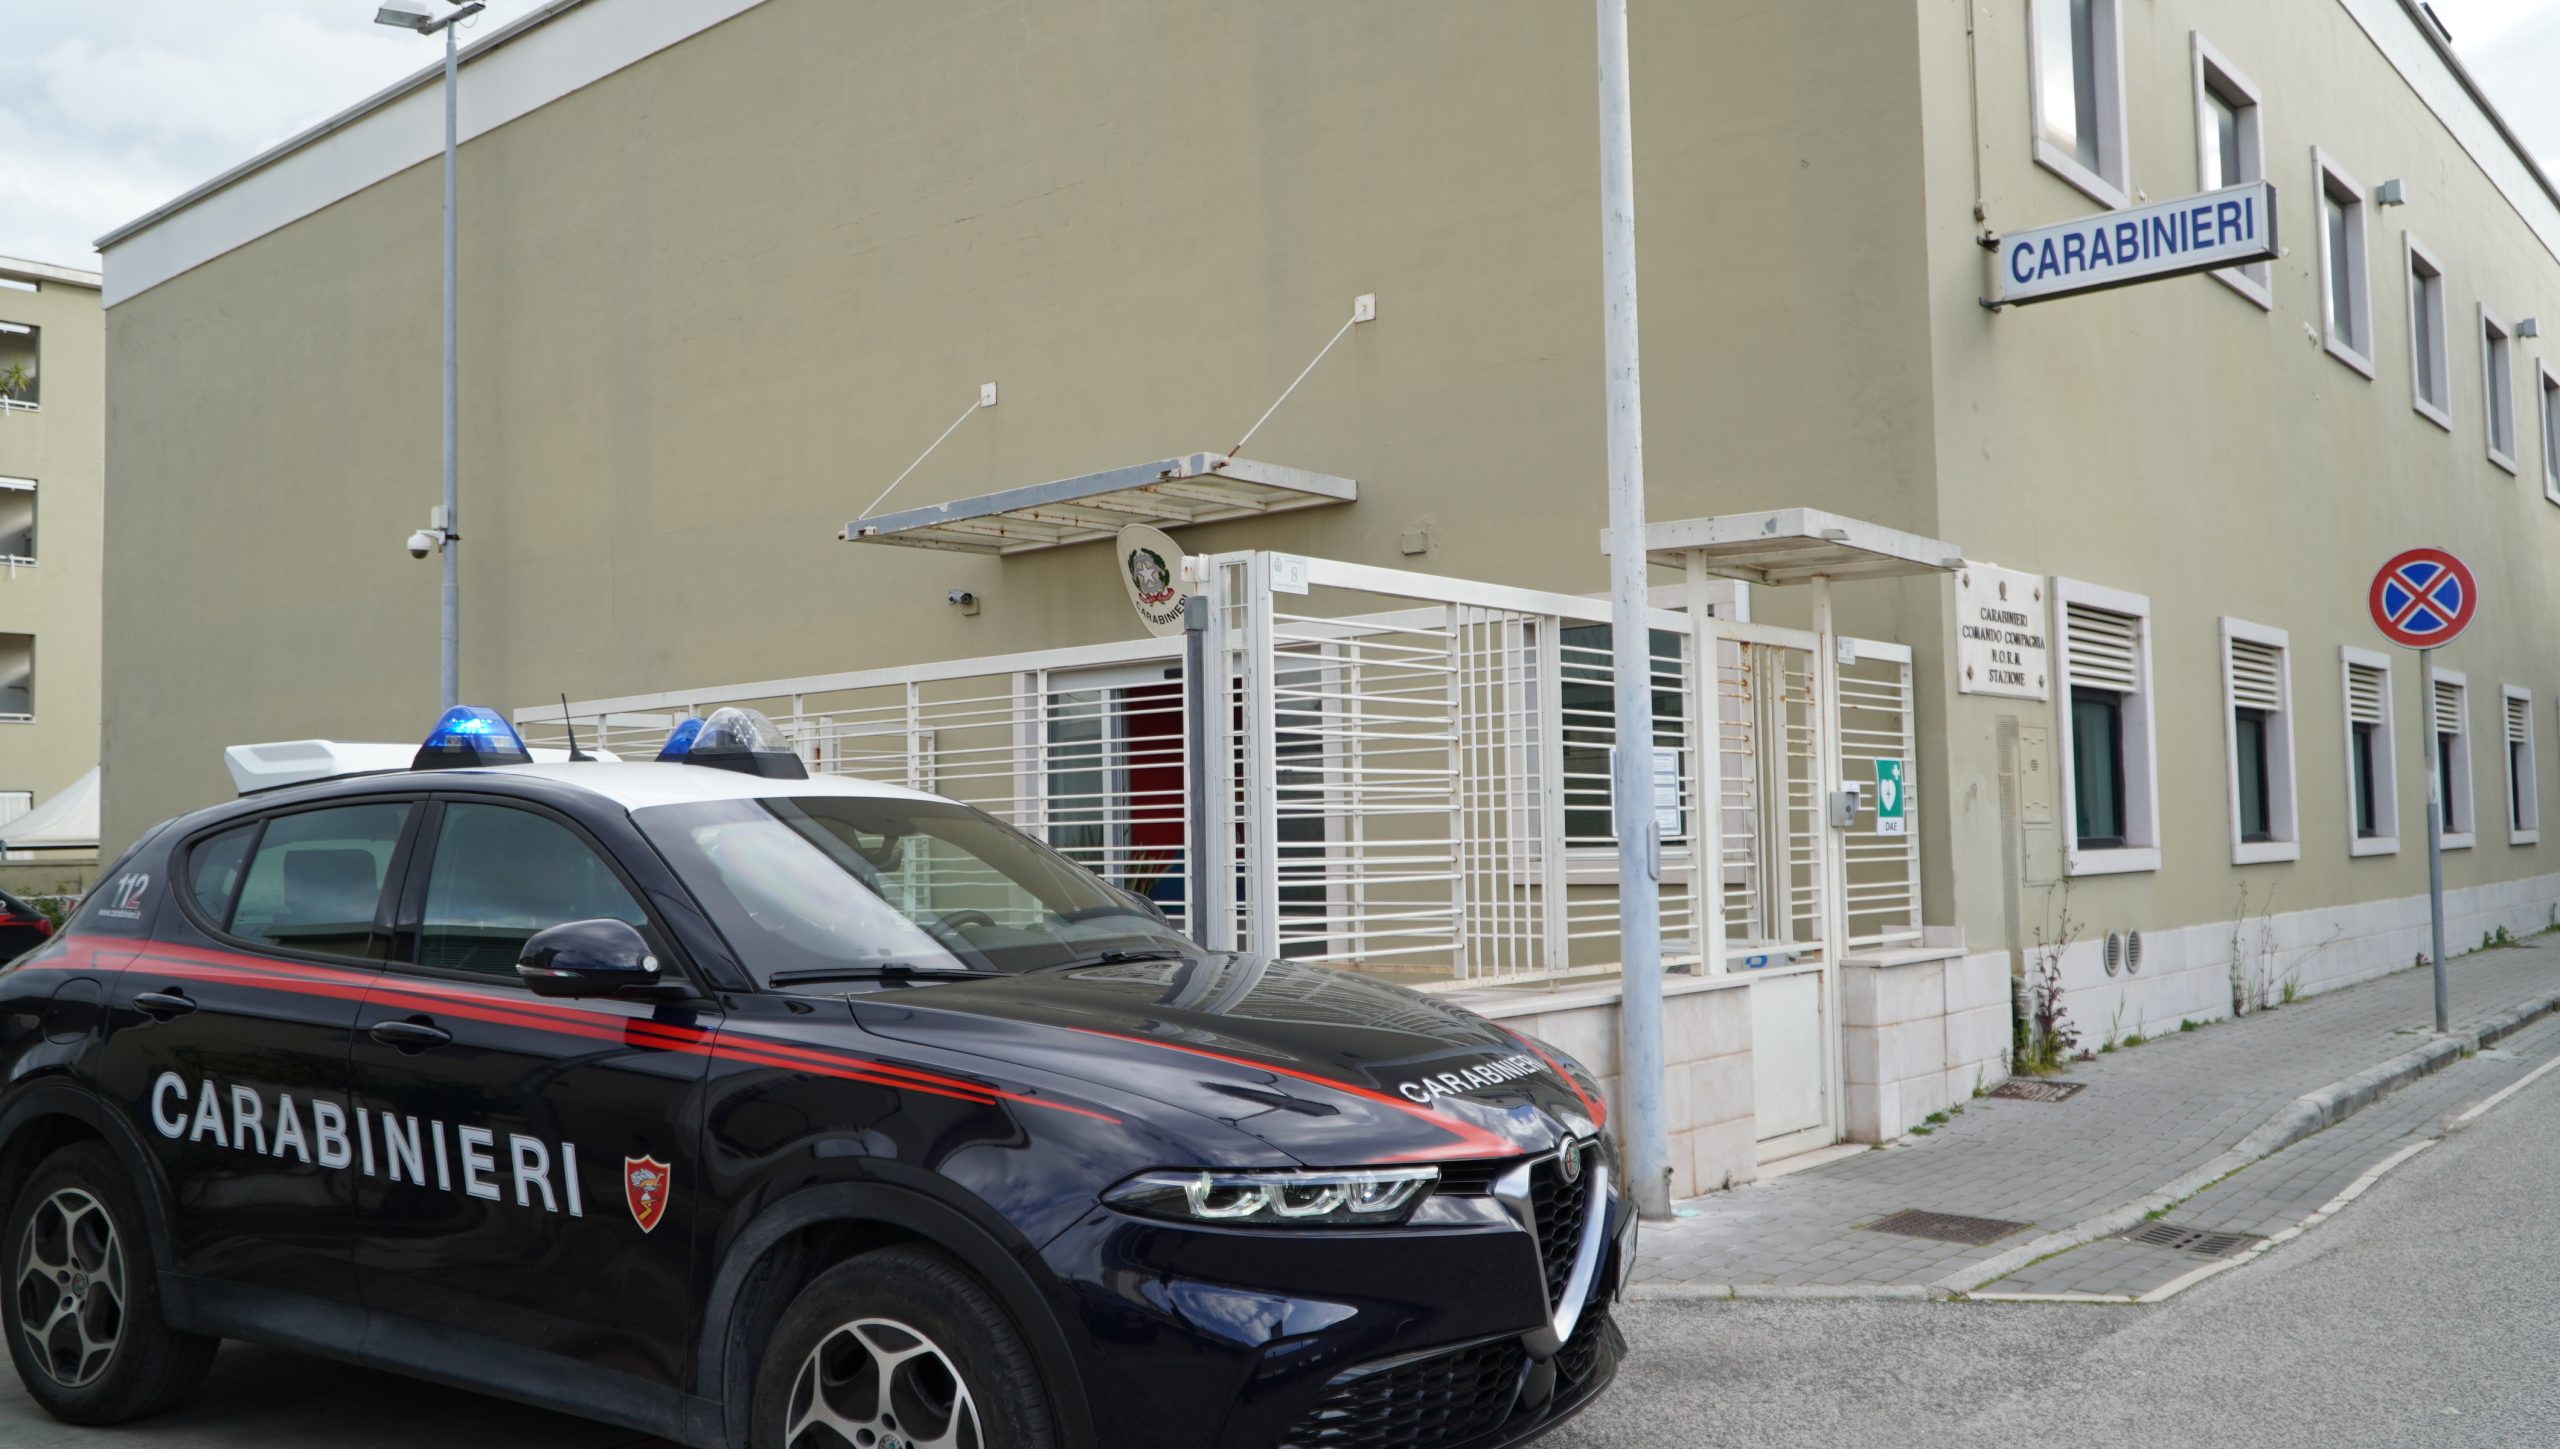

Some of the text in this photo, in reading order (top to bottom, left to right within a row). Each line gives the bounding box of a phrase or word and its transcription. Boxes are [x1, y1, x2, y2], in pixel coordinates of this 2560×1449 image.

[2011, 197, 2255, 284] CARABINIERI
[1980, 607, 2027, 627] CARABINIERI
[1962, 625, 2045, 650] COMANDO COMPAGNIA
[1989, 669, 2026, 686] STAZIONE
[1885, 822, 1897, 831] DAE
[111, 872, 150, 910] 112
[1399, 1053, 1546, 1104] CARABINIERI
[151, 1070, 583, 1218] CARABINIERI
